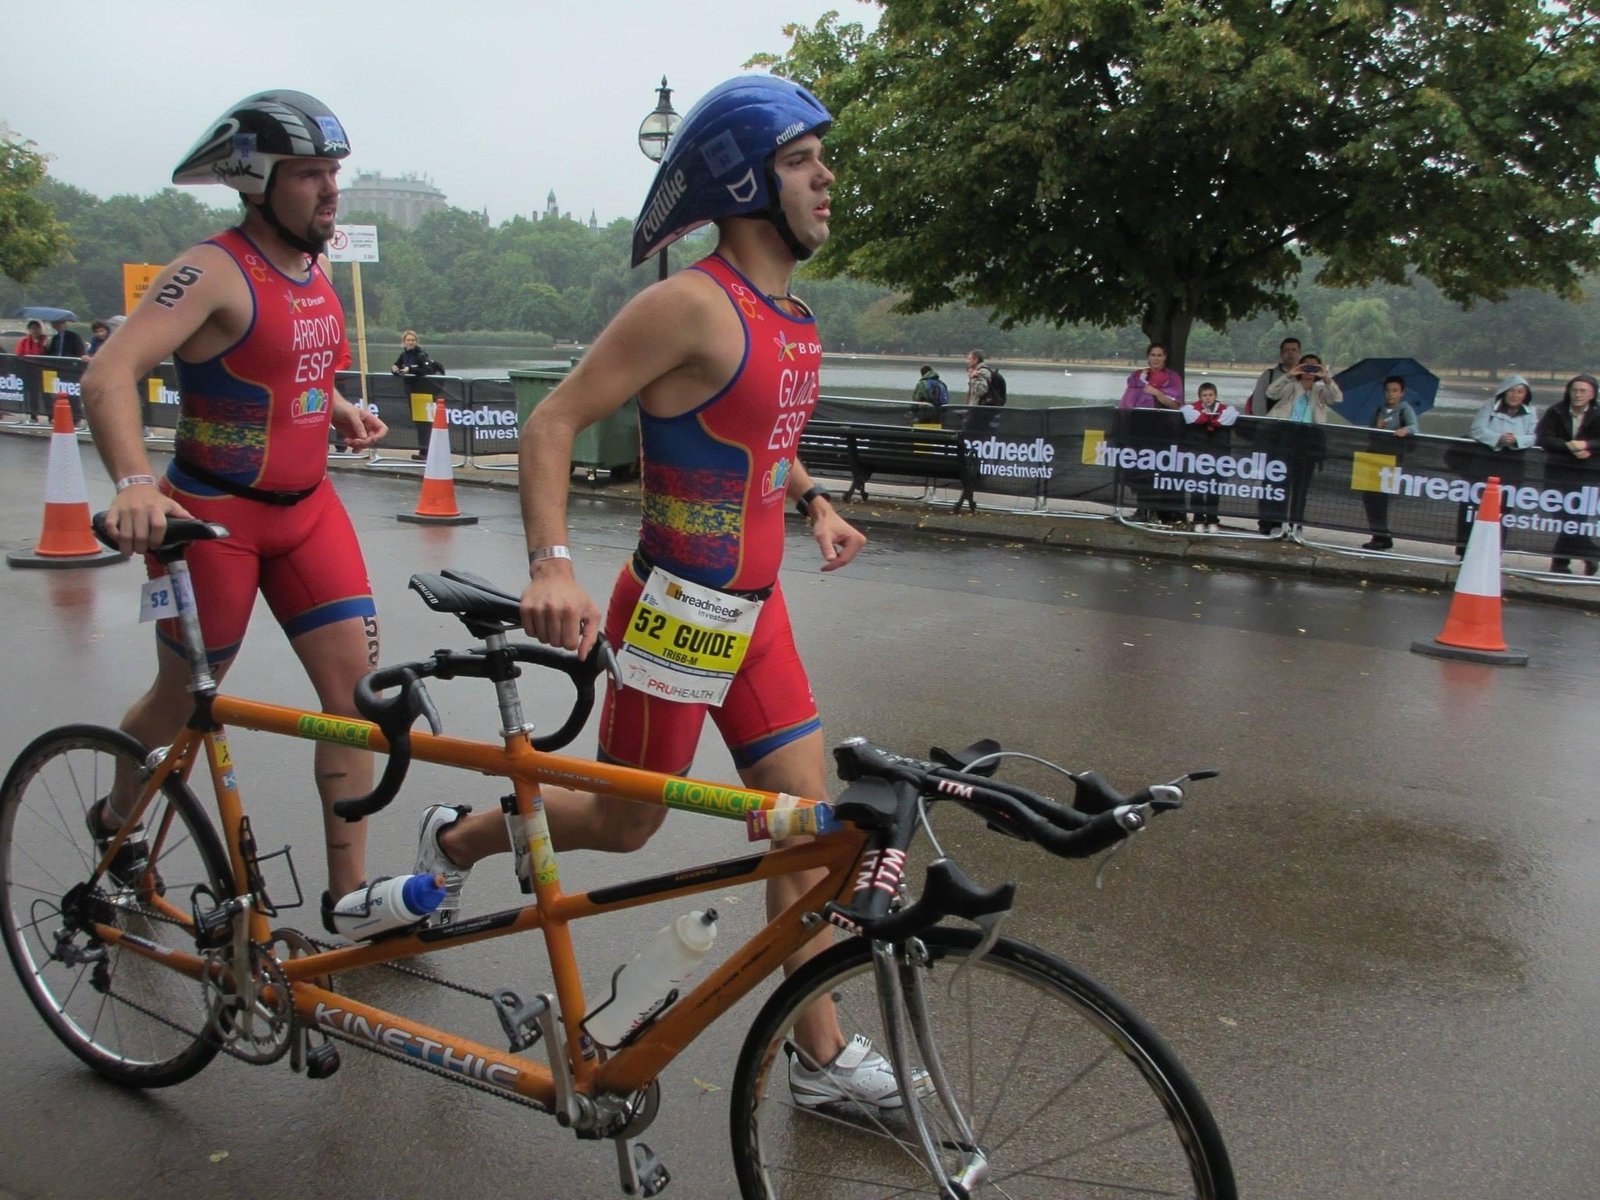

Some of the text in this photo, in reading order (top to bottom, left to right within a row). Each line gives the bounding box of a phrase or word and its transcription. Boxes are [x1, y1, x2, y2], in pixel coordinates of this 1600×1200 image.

[775, 121, 806, 146] catlike
[641, 169, 688, 243] catlike
[292, 314, 341, 352] ARROYO
[798, 342, 807, 354] B
[294, 350, 333, 383] ESP
[767, 410, 806, 450] ESP
[979, 460, 1054, 479] investments
[1094, 440, 1288, 482] threadneedle
[1153, 472, 1286, 501] investments
[1378, 466, 1600, 516] threaneedl
[150, 589, 169, 609] 52
[634, 606, 738, 659] 52 GUIDE
[647, 677, 715, 701] PRUHEALTH
[314, 719, 370, 743] ONCE
[686, 785, 763, 812] ONCE
[937, 780, 975, 799] ITM
[873, 847, 907, 895] ITM
[314, 1002, 519, 1084] KINETHIC
